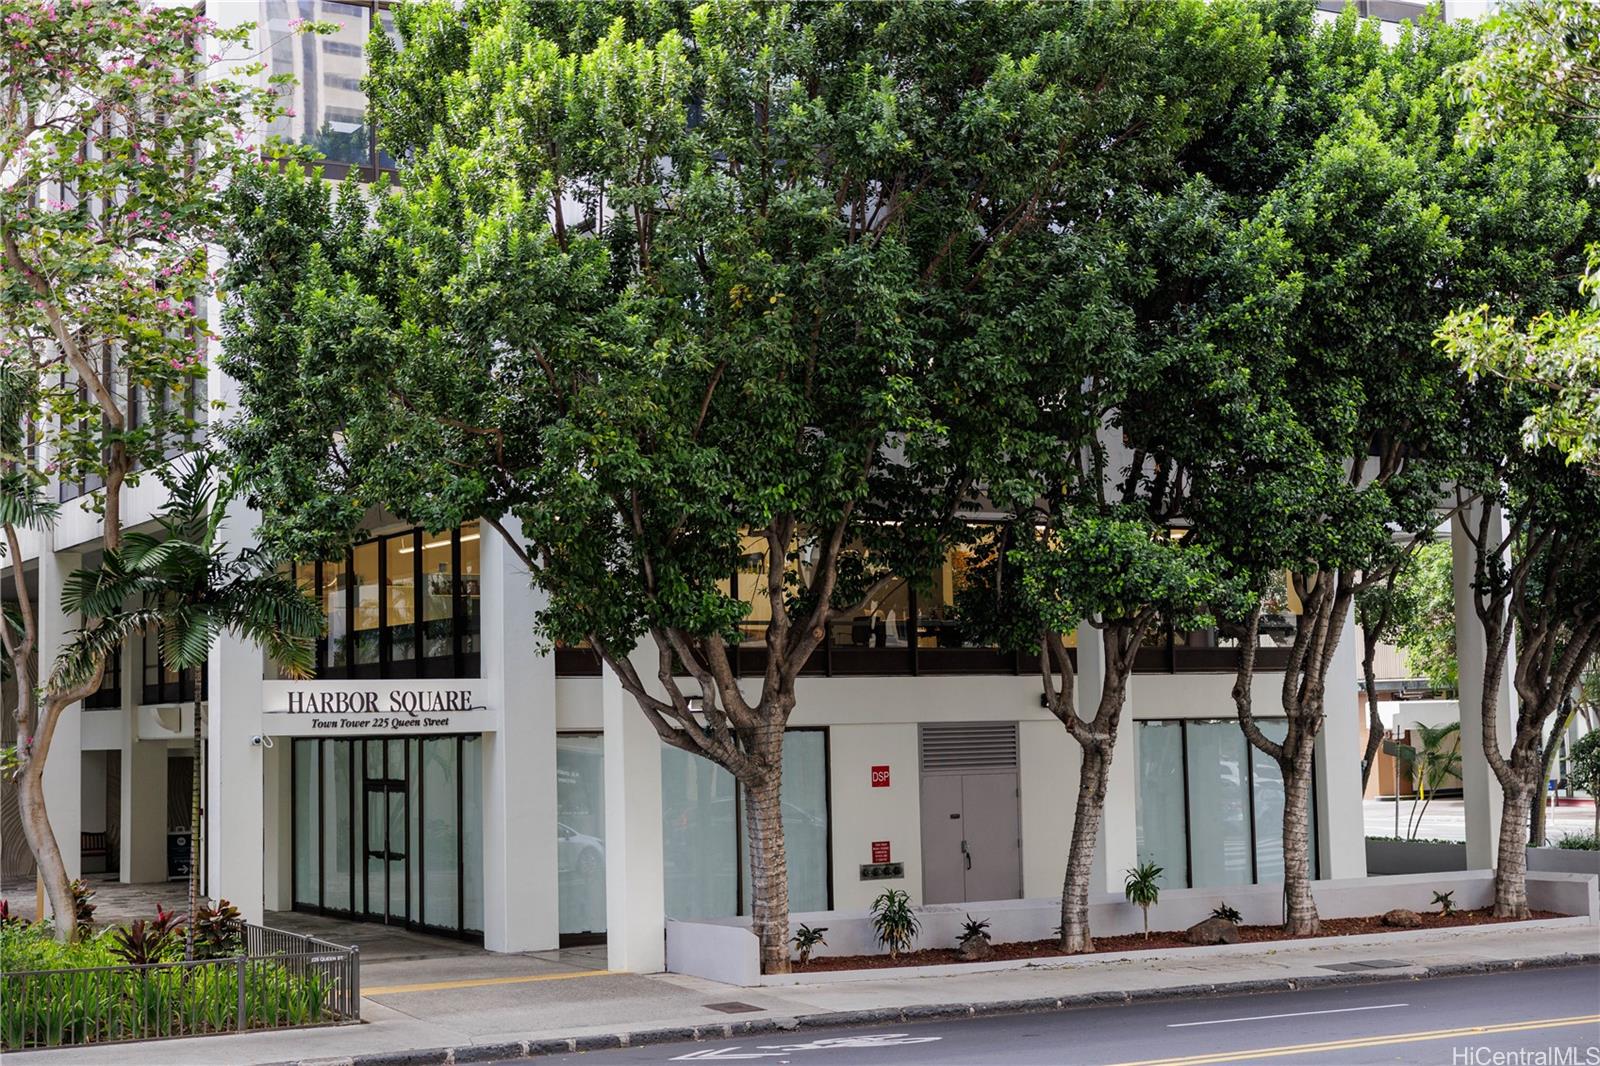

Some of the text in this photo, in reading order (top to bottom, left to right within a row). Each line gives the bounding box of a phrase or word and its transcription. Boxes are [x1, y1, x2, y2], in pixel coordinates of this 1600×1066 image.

[287, 690, 472, 717] HARBOR SQUARE
[312, 717, 449, 729] Town Tower 225 Queen Street
[872, 771, 889, 783] DSP
